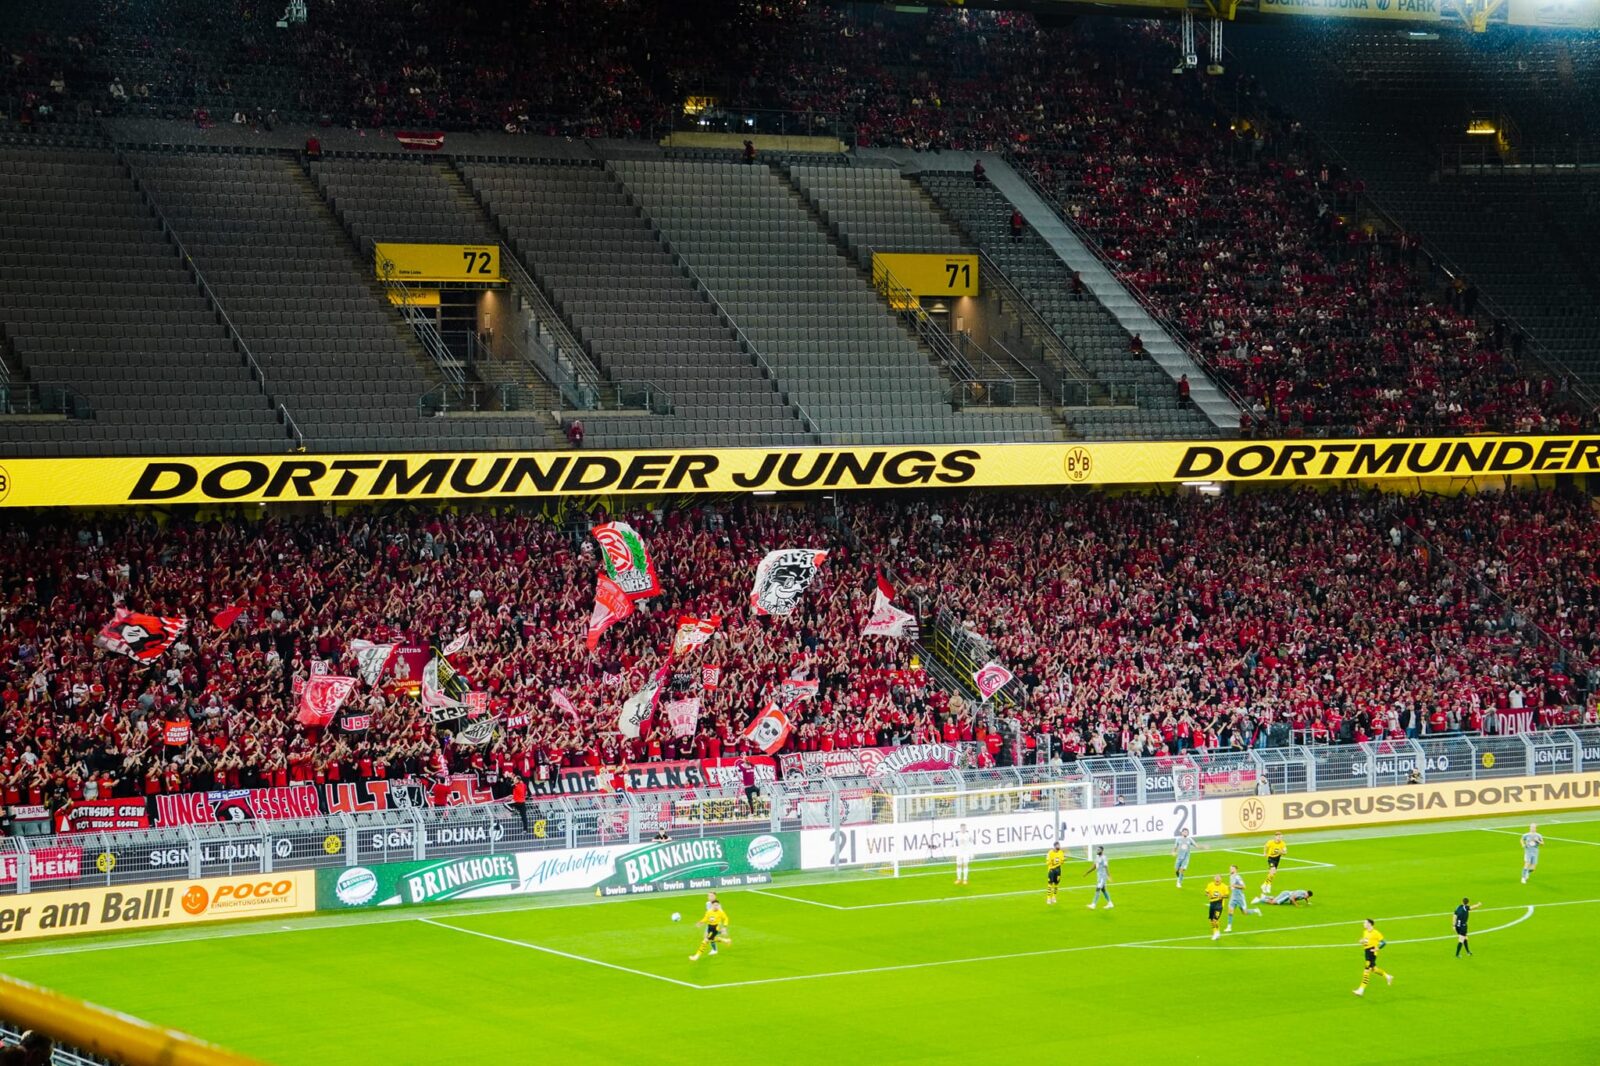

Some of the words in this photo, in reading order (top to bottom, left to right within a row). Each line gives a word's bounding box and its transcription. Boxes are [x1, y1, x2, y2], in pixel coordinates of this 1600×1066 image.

[1397, 0, 1436, 12] PARK
[464, 252, 492, 274] 72
[945, 264, 970, 288] 71
[1068, 450, 1089, 471] BVB
[1173, 439, 1600, 478] DORTMUNDER
[127, 453, 719, 500] DORTMUNDER
[731, 449, 982, 488] JUNGS
[1074, 470, 1083, 479] 09
[876, 740, 963, 776] RUHRPOTT
[631, 761, 700, 790] FANS
[705, 764, 776, 784] FREKS
[119, 806, 146, 817] CREW
[154, 791, 217, 828] JUNGE
[250, 785, 322, 820] ESSENER
[1243, 801, 1262, 821] BVB
[1283, 791, 1448, 820] BORUSSIA
[372, 830, 433, 849] SGNL
[437, 826, 486, 843] IDUNA
[1080, 816, 1164, 837] www.21.de
[524, 850, 610, 890] Alkoholfrei
[721, 876, 741, 886] bwin
[747, 873, 767, 883] bwin
[212, 880, 292, 903] POCO
[606, 886, 627, 895] bwin
[632, 883, 653, 893] bwin
[664, 881, 685, 890] bwin
[690, 879, 710, 888] bwin
[39, 900, 89, 930] am
[100, 887, 174, 923] Ball!
